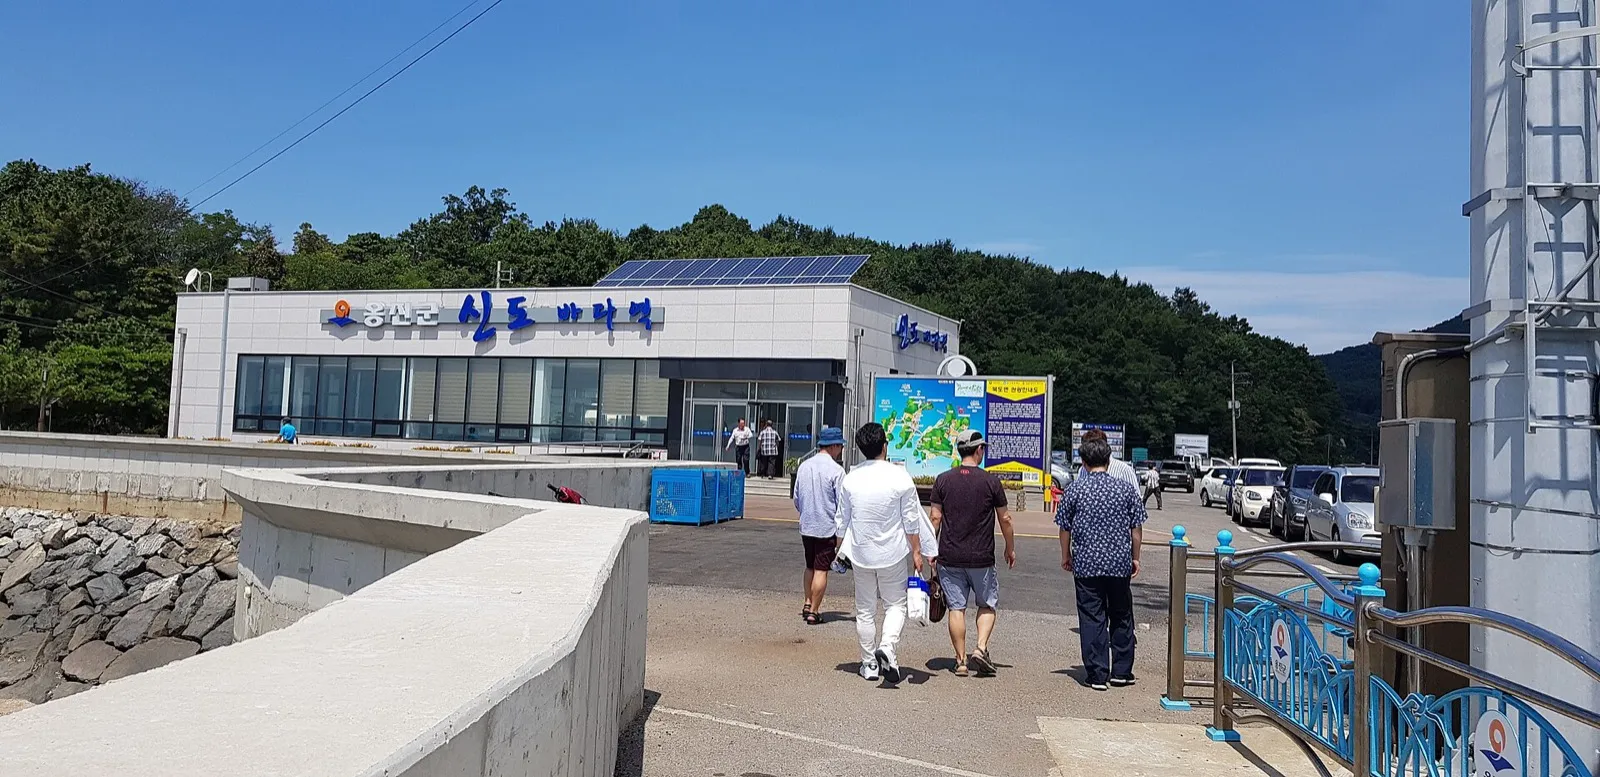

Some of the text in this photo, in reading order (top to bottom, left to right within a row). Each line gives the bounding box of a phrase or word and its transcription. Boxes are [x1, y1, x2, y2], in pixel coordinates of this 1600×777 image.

[363, 301, 439, 327] 옹진군
[458, 291, 535, 342] 신도
[896, 313, 919, 350] 신도
